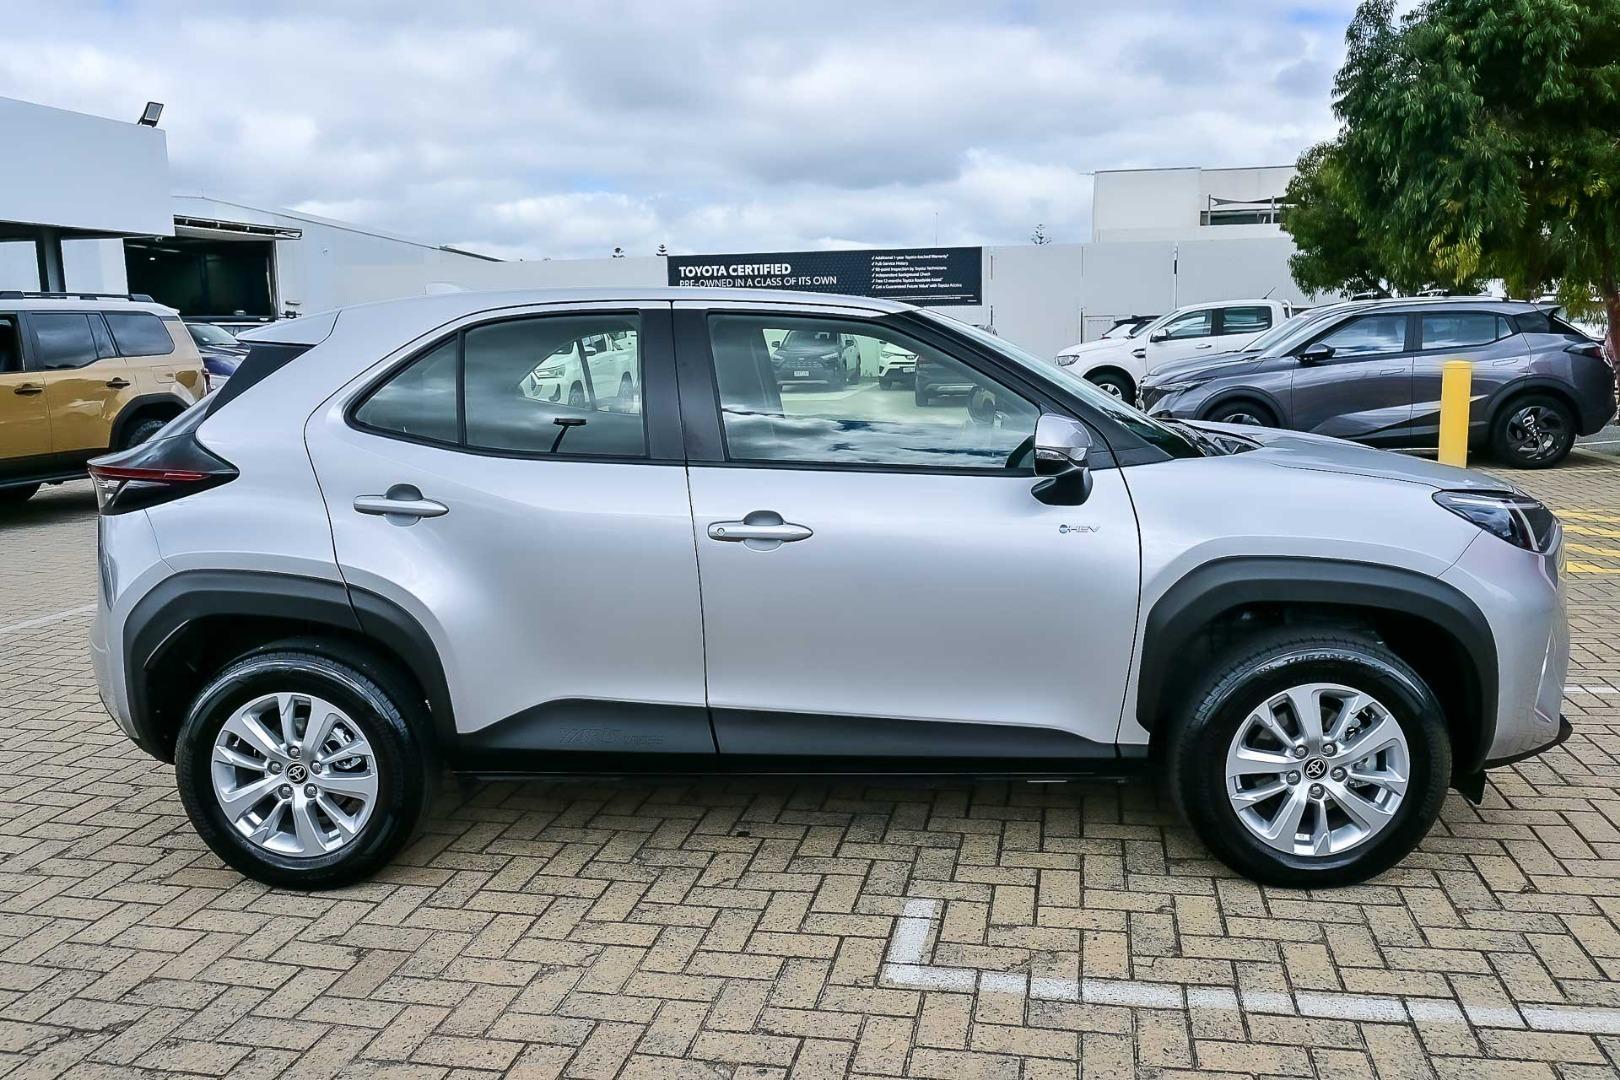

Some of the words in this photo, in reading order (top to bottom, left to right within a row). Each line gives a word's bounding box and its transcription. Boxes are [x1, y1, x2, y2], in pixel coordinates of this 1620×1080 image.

[679, 265, 727, 277] TOYOTA
[729, 263, 792, 276] CERTIFIED
[680, 279, 734, 288] PRE-OWNED
[735, 278, 745, 287] IN
[747, 278, 753, 287] A
[754, 277, 782, 287] CLASS
[783, 276, 797, 286] OF
[798, 276, 811, 286] ITS
[813, 275, 837, 285] OWN
